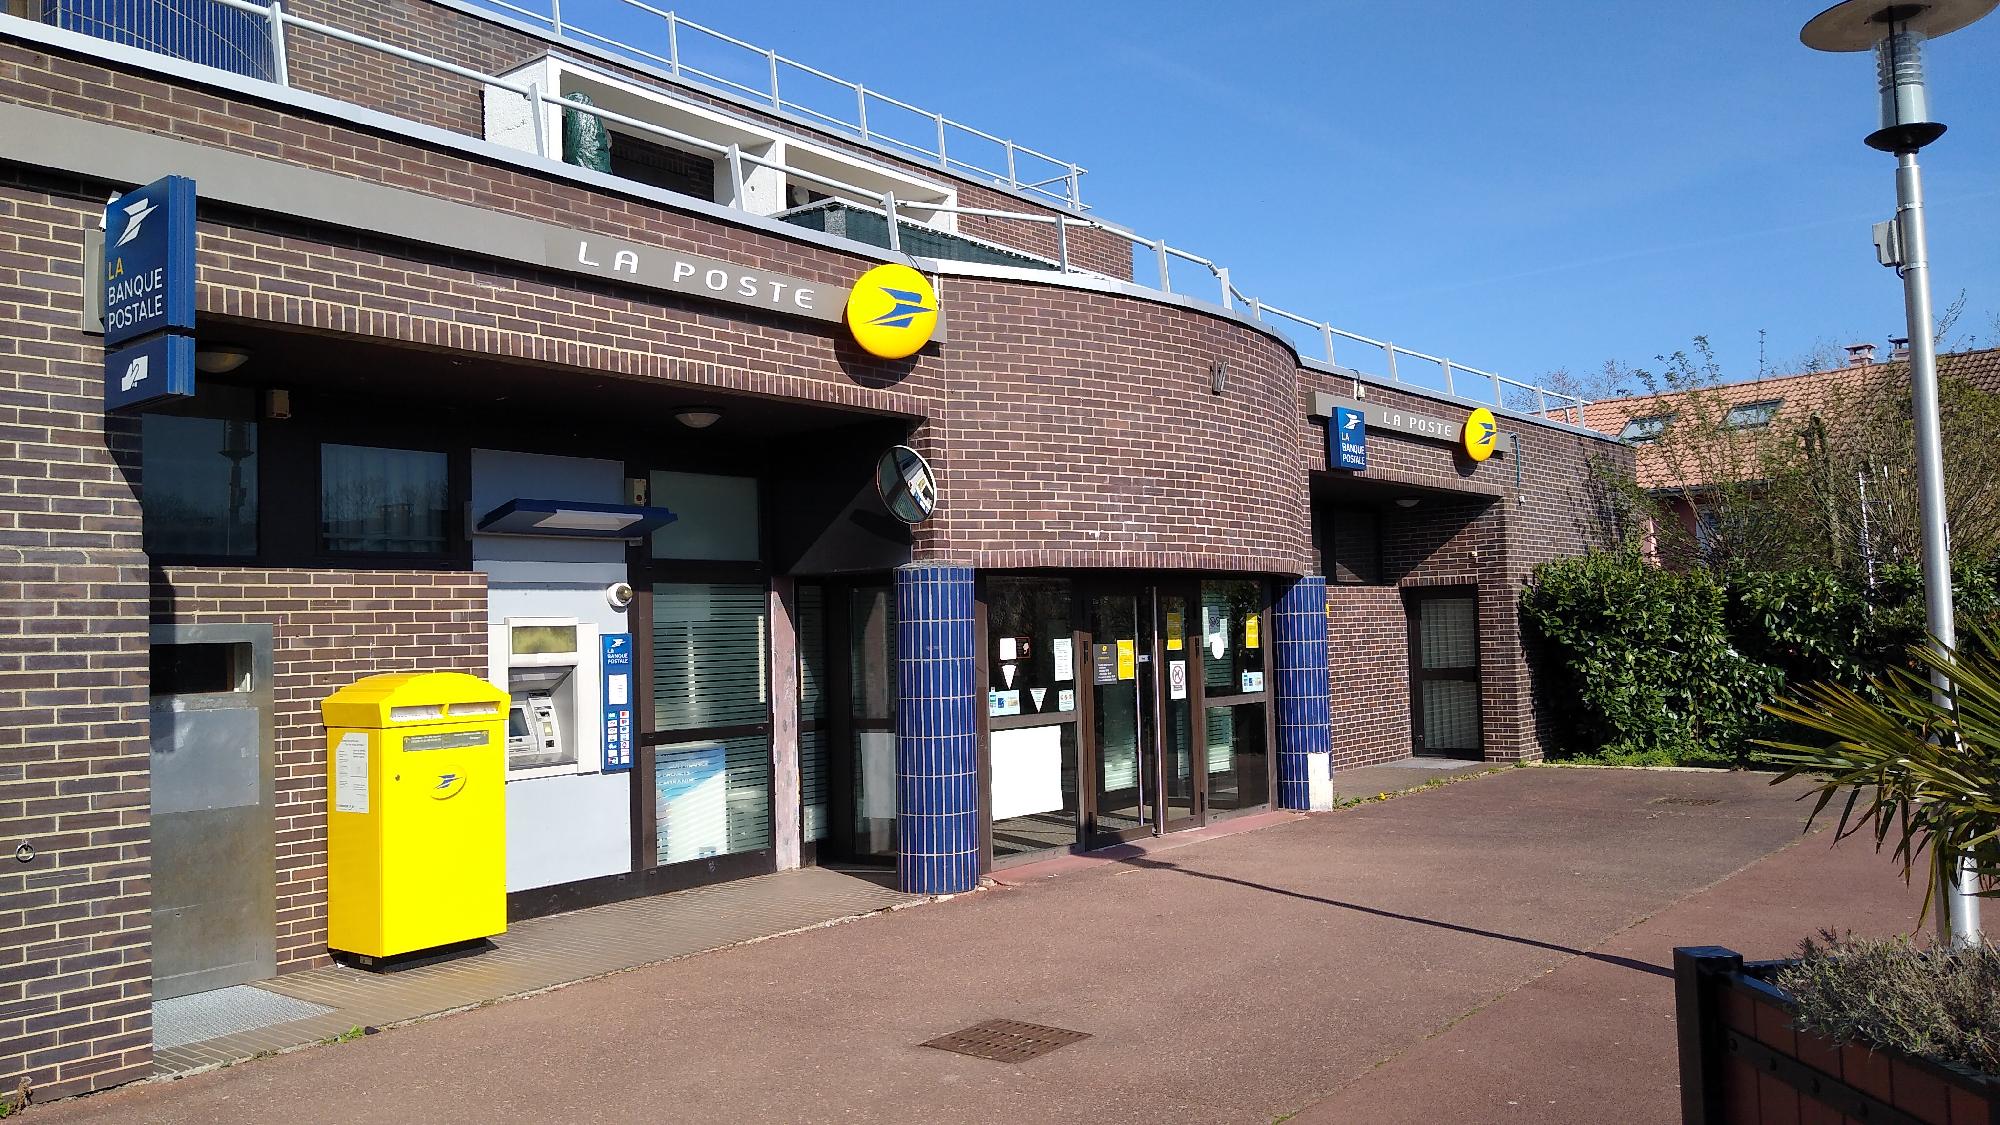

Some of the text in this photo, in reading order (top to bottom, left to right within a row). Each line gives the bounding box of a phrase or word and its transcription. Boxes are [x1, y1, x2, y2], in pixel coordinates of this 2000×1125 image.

[108, 257, 124, 281] LA
[577, 241, 815, 310] LA POSTE
[108, 267, 163, 307] BANQUE
[108, 294, 163, 333] POSTALE
[1341, 431, 1350, 442] LA
[1383, 412, 1452, 437] LA POSTE
[1341, 442, 1365, 455] BANQUE
[1342, 454, 1366, 466] POSTALE
